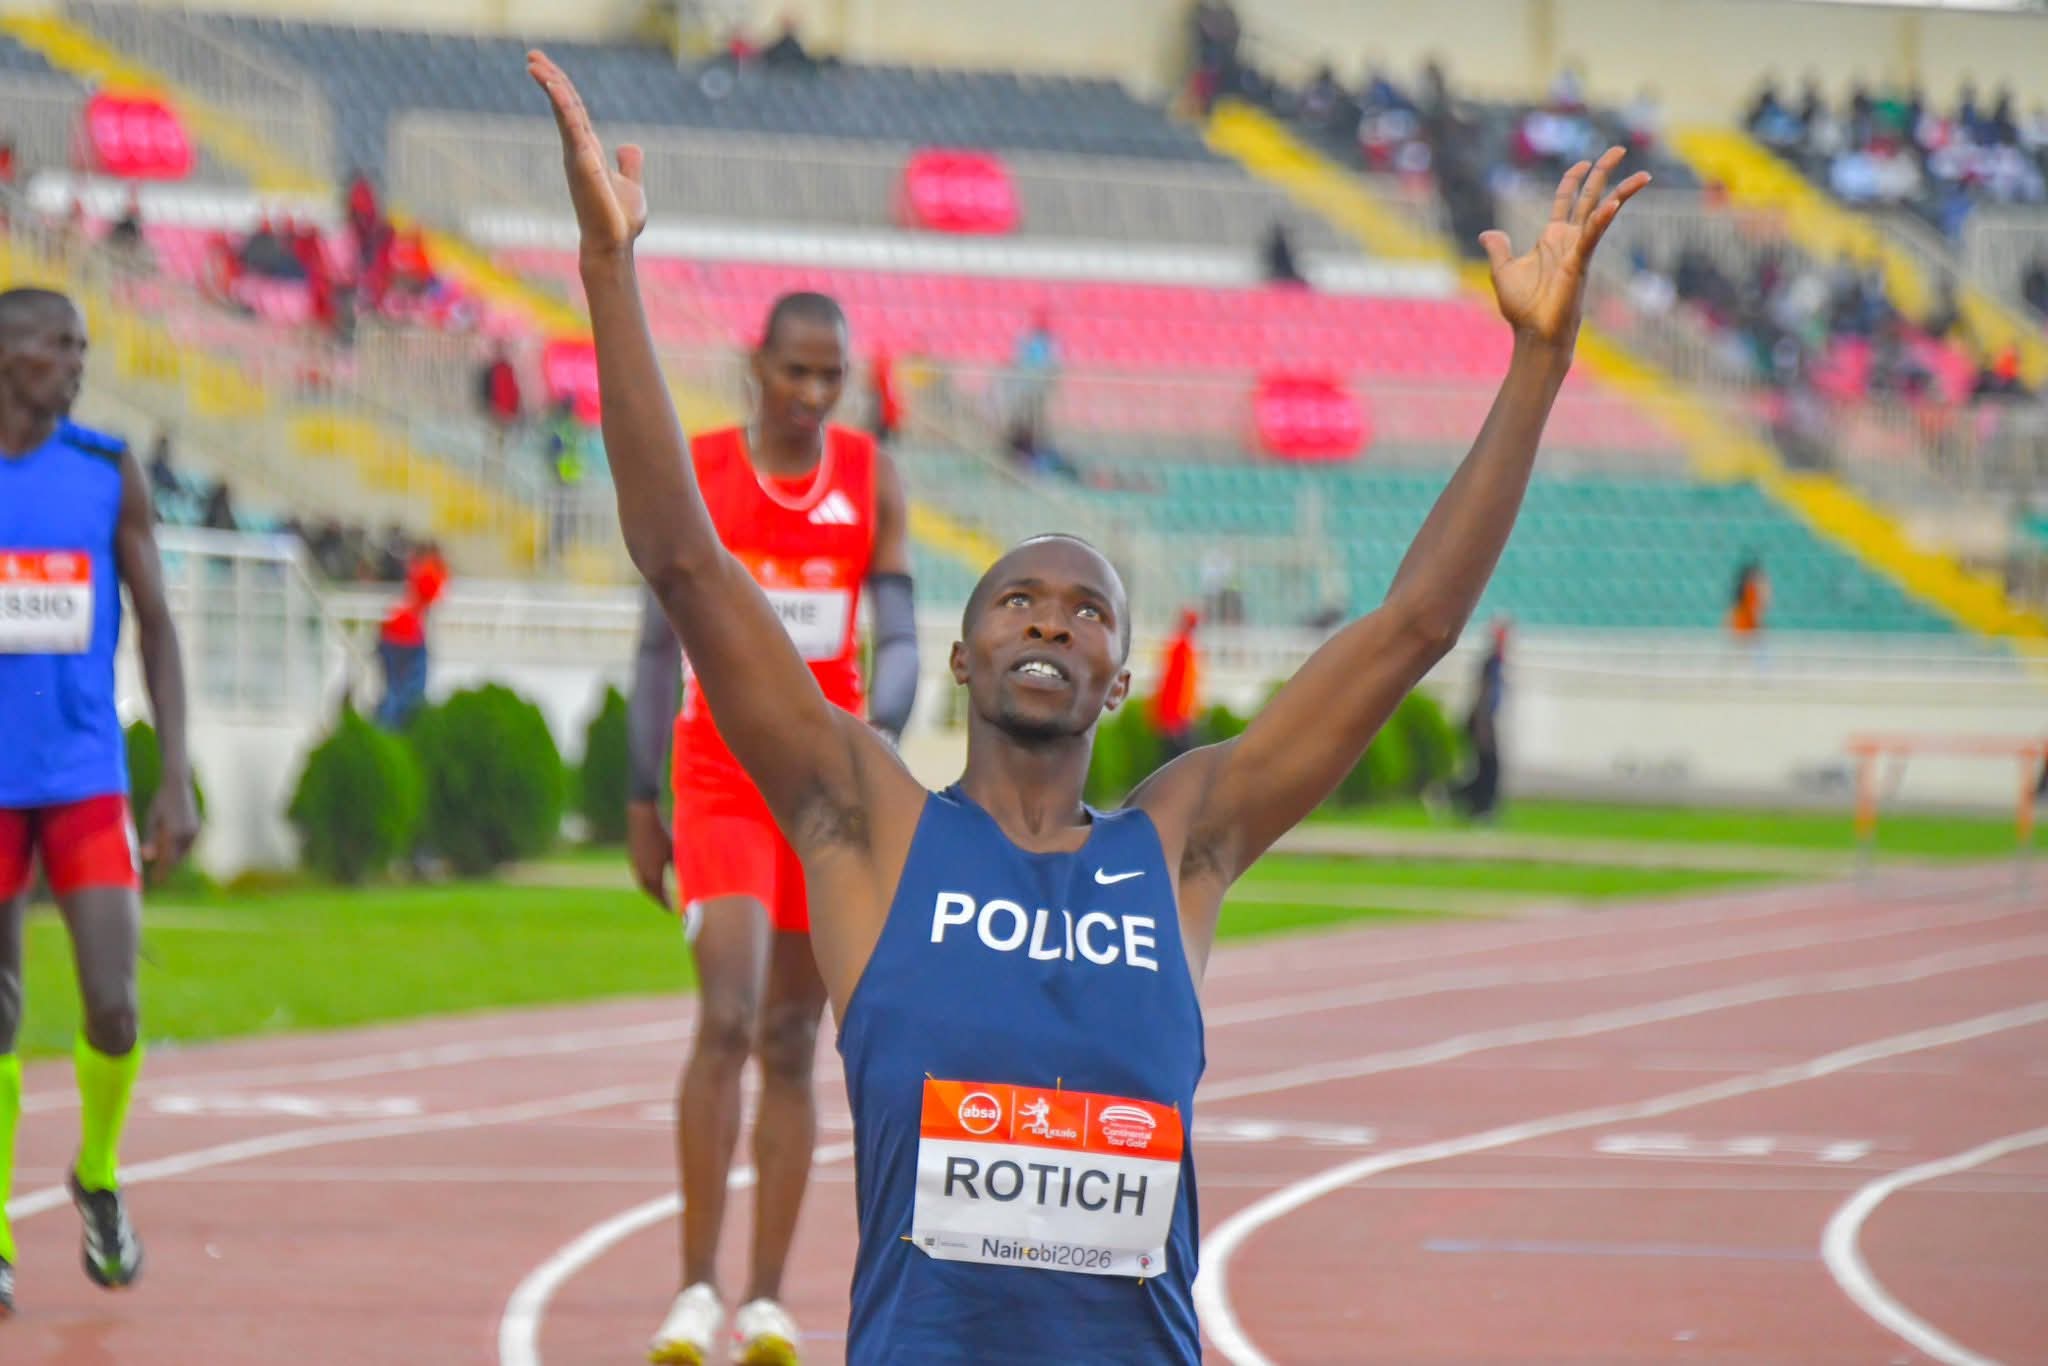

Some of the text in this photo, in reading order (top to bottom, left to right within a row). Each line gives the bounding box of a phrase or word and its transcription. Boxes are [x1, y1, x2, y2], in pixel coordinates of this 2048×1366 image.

[930, 891, 1159, 972] POLICE
[962, 1104, 996, 1119] absa
[944, 1156, 1148, 1217] ROTICH
[981, 1238, 1112, 1269] Nairobi2026
